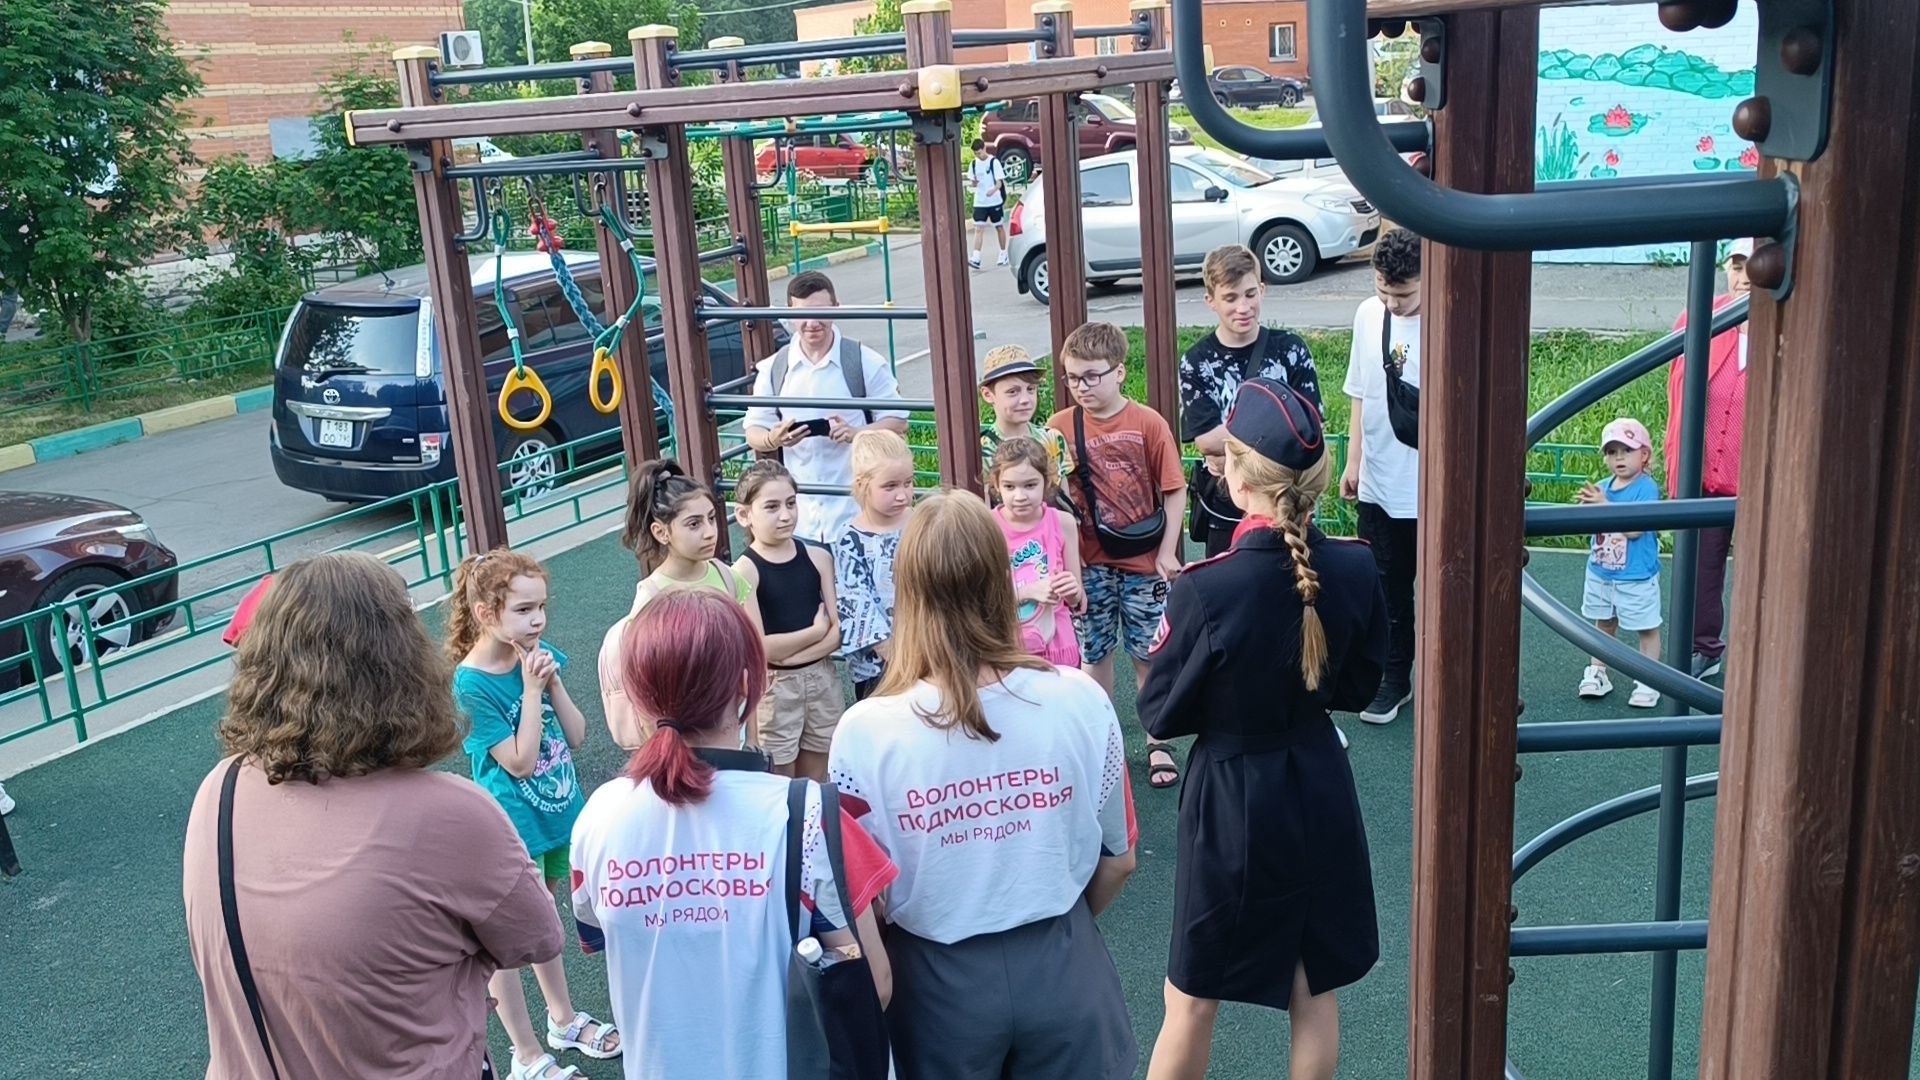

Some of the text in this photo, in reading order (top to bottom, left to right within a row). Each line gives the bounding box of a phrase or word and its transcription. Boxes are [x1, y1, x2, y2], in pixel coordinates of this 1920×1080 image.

[907, 766, 1059, 809] ВОЛОНТЕРЫ
[897, 786, 1073, 833] ПОДМОСКОВЬЯ
[940, 819, 1031, 847] МЫ РЯДОМ
[607, 852, 764, 880] ВОЛОНТЕРЫ
[645, 912, 667, 927] МЫ
